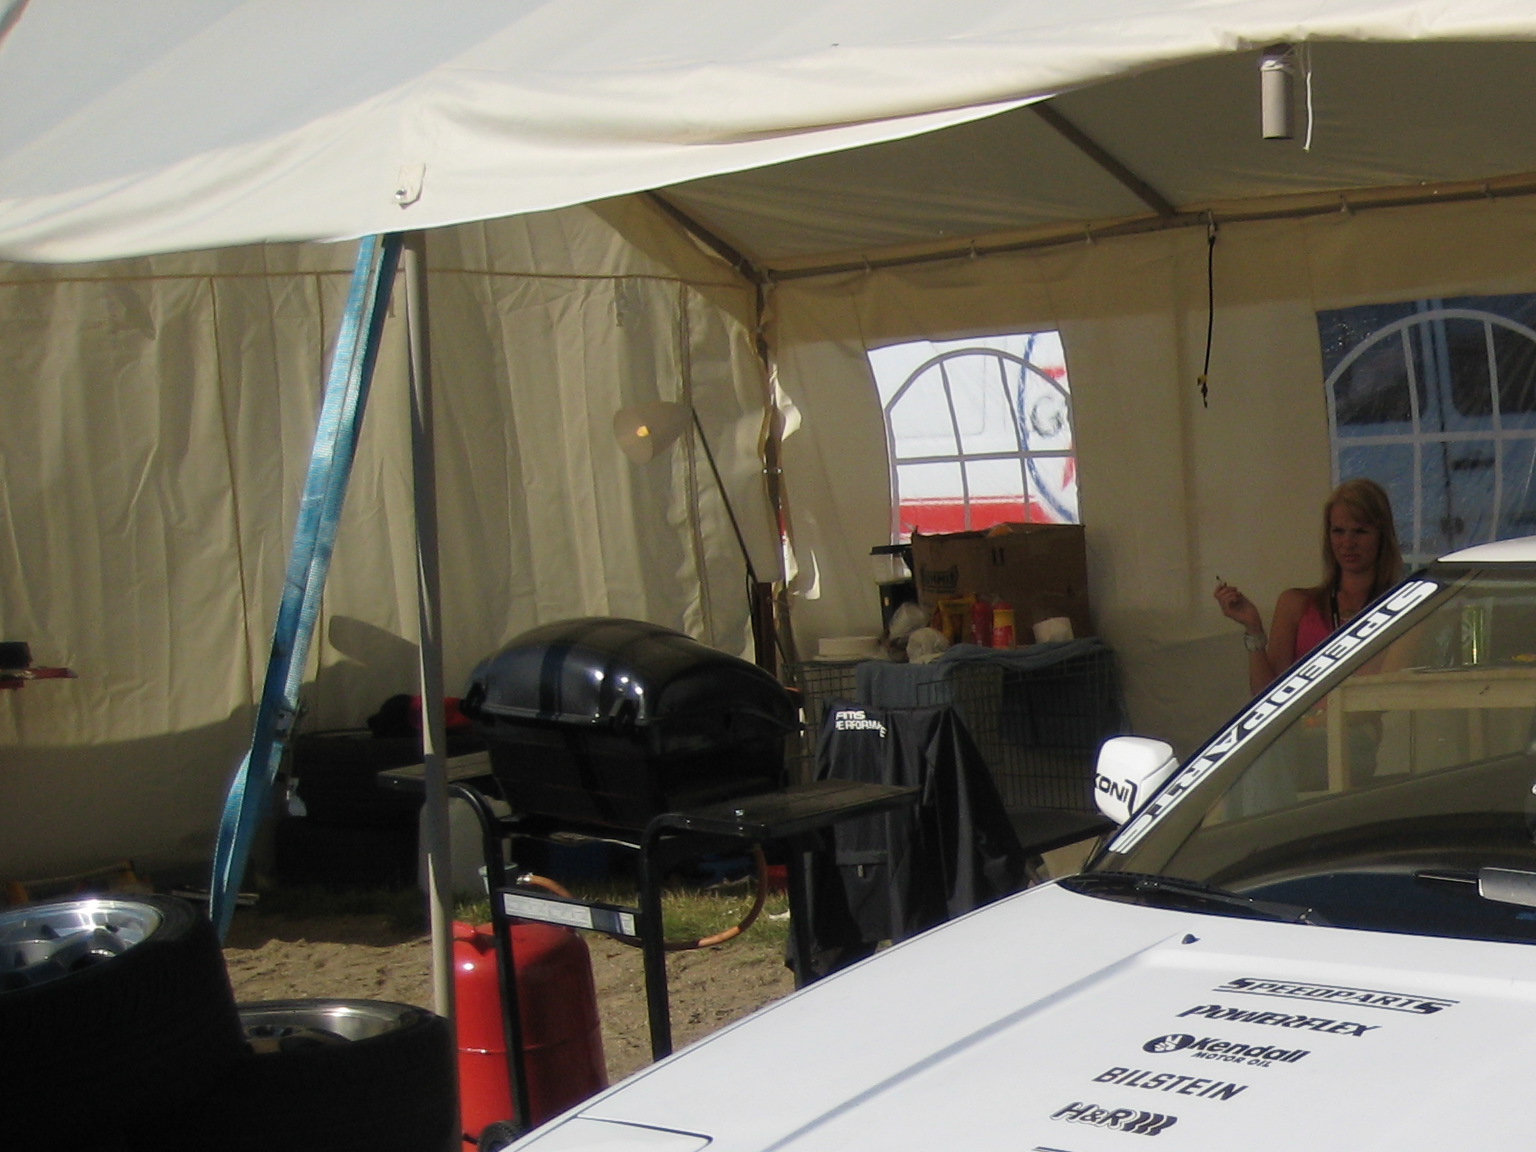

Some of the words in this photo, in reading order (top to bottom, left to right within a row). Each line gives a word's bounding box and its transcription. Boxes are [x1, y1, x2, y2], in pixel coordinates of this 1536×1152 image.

[1109, 579, 1439, 854] SPEEDPARTS
[1212, 977, 1461, 1014] SPEEDPARTS
[1175, 1003, 1382, 1037] POWERFLEX
[1189, 1036, 1311, 1064] Kendall
[1191, 1051, 1243, 1065] MOTOR
[1246, 1057, 1272, 1068] OIL
[1092, 1066, 1249, 1101] BILSTEIN
[1051, 1102, 1135, 1130] H&R
